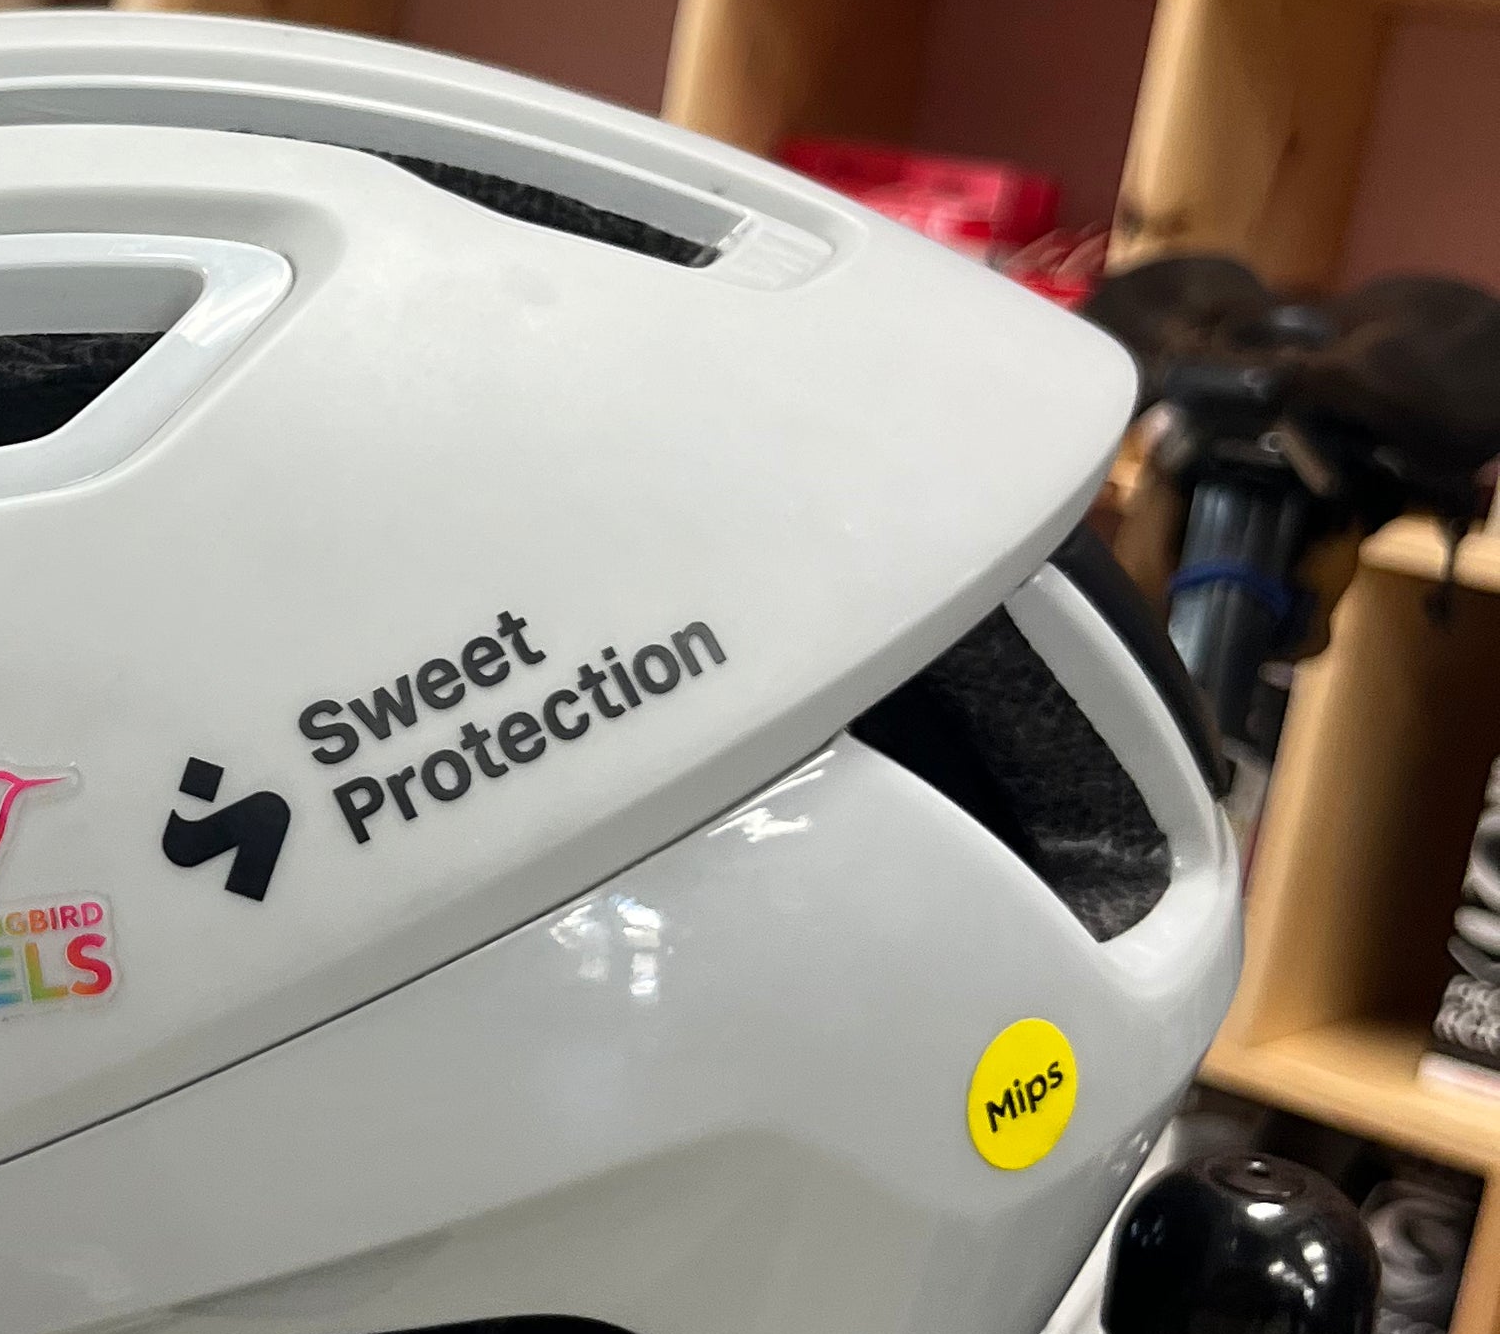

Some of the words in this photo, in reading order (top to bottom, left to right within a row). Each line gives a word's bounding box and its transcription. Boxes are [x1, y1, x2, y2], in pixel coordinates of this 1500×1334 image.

[298, 610, 546, 765] Sweet
[332, 620, 727, 845] Protection
[986, 1060, 1064, 1134] Mips
